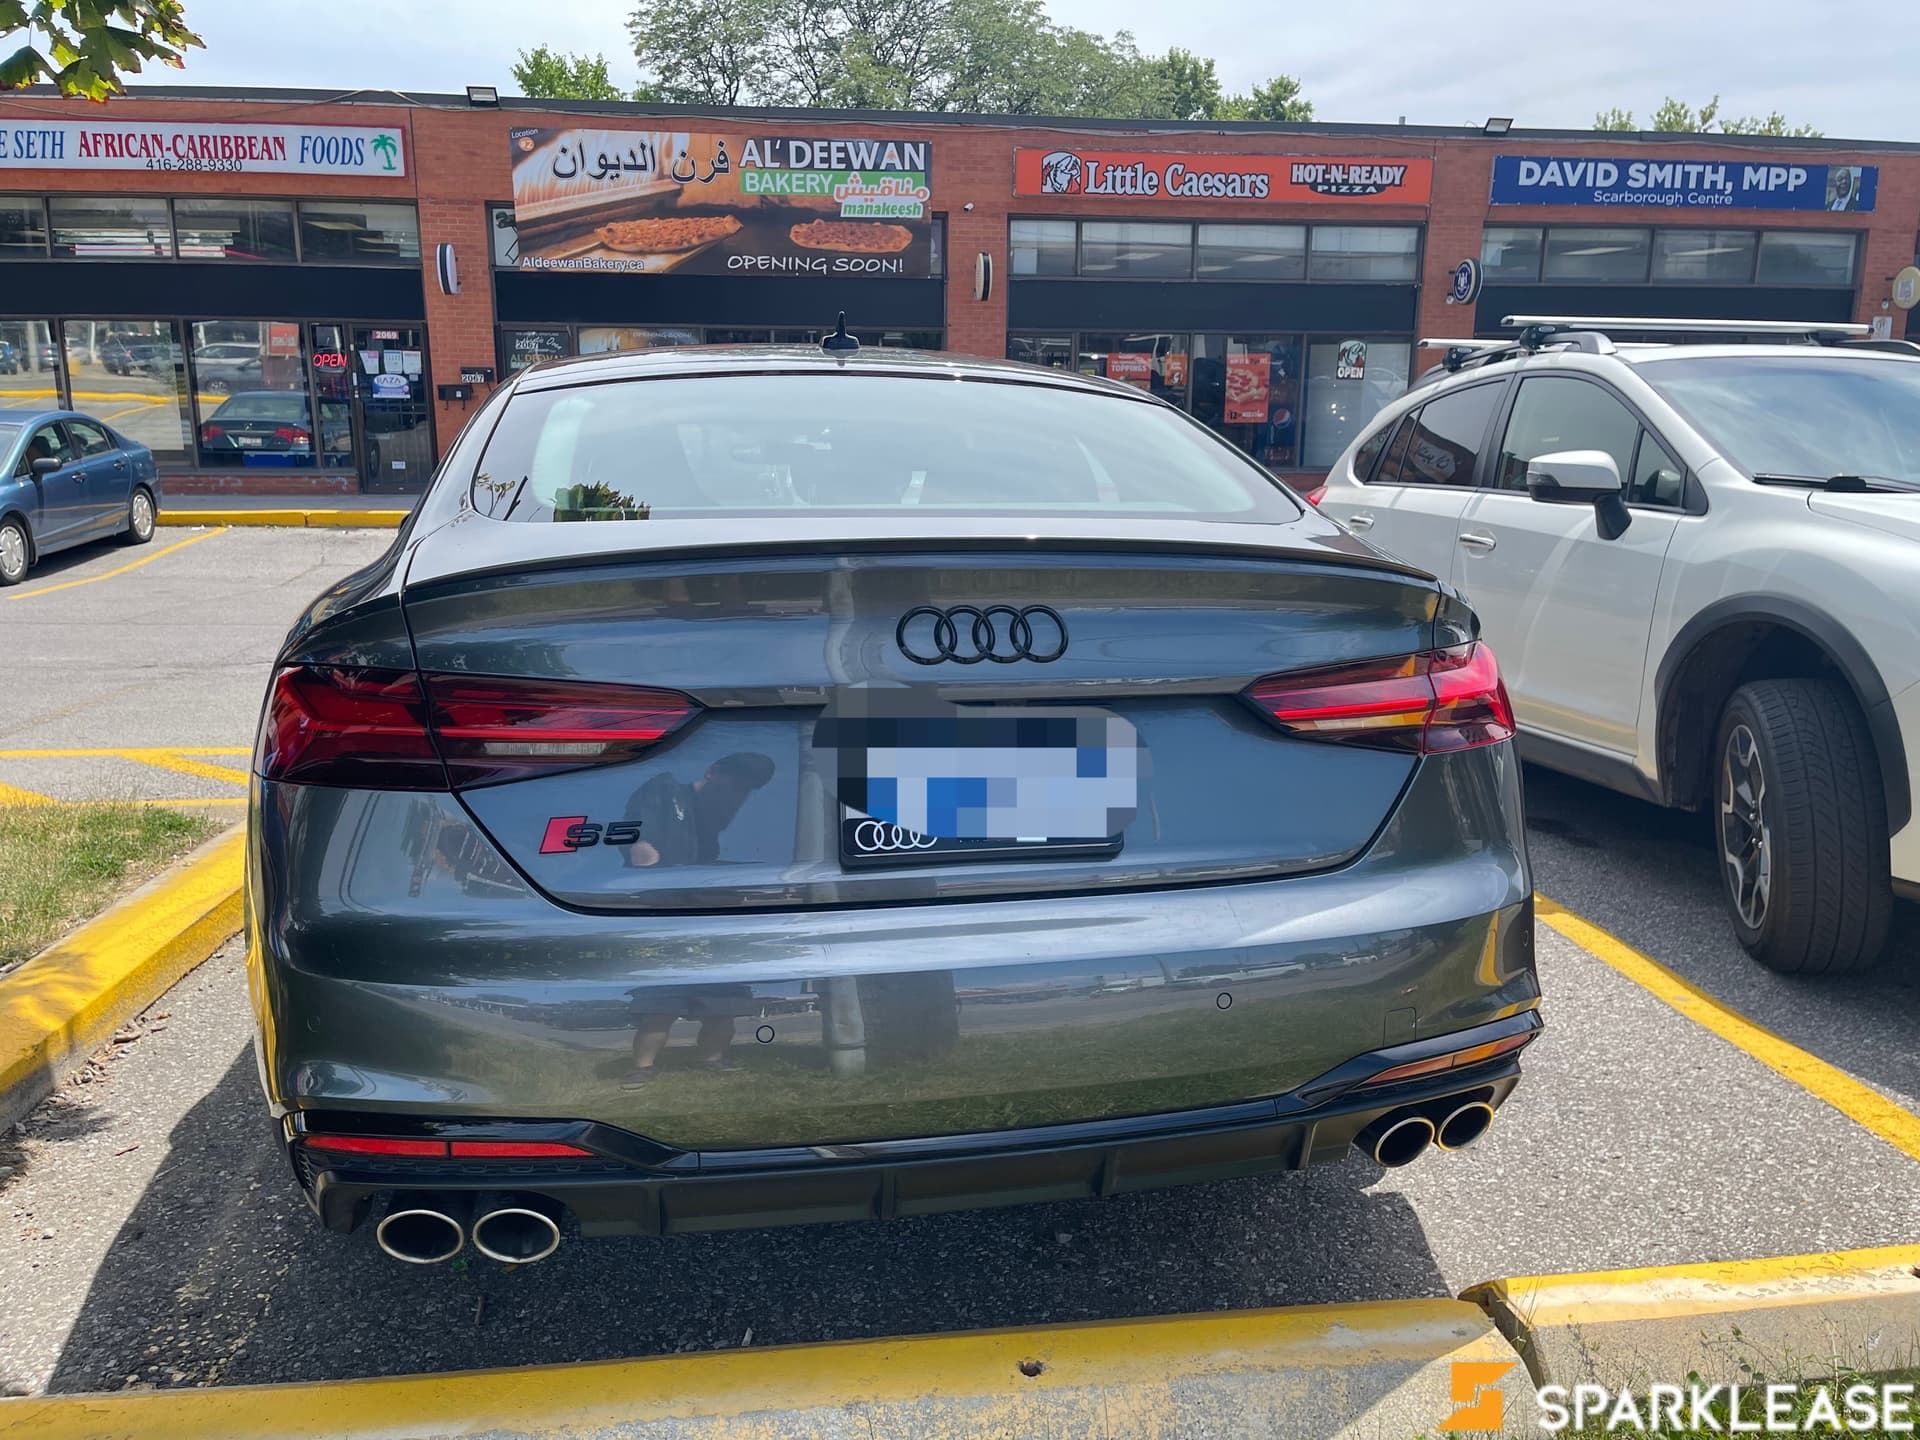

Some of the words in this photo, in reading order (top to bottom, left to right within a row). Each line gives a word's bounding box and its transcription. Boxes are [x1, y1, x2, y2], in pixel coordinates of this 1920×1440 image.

[511, 129, 539, 139] Location
[13, 130, 65, 159] SETH
[78, 130, 287, 161] AFRICAN-CARIBBEAN
[299, 135, 364, 166] FOODS
[789, 140, 925, 170] DEEWAN
[146, 158, 243, 171] 416-288-9330
[552, 140, 656, 181] الديوان
[671, 140, 730, 183] فرن
[745, 172, 833, 193] BAKERY
[1085, 161, 1158, 196] Little
[1165, 163, 1269, 198] Caesars
[1292, 164, 1405, 185] HOT-N-READY
[1518, 161, 1619, 188] DAVID
[1627, 163, 1734, 194] SMITH,
[1742, 166, 1808, 192] MPP
[835, 173, 929, 202] مناقيش
[1317, 185, 1378, 193] PIZZA
[1593, 190, 1684, 206] Scarborough
[1687, 192, 1733, 205] Centre
[843, 202, 922, 216] manakeesh
[522, 256, 644, 271] AldeewanBakery.ca
[727, 255, 828, 276] OPENING
[832, 258, 903, 273] SOON!
[375, 331, 398, 339] 2069
[313, 353, 347, 367] OPEN
[1337, 367, 1364, 378] OPEN
[563, 820, 643, 848] S5
